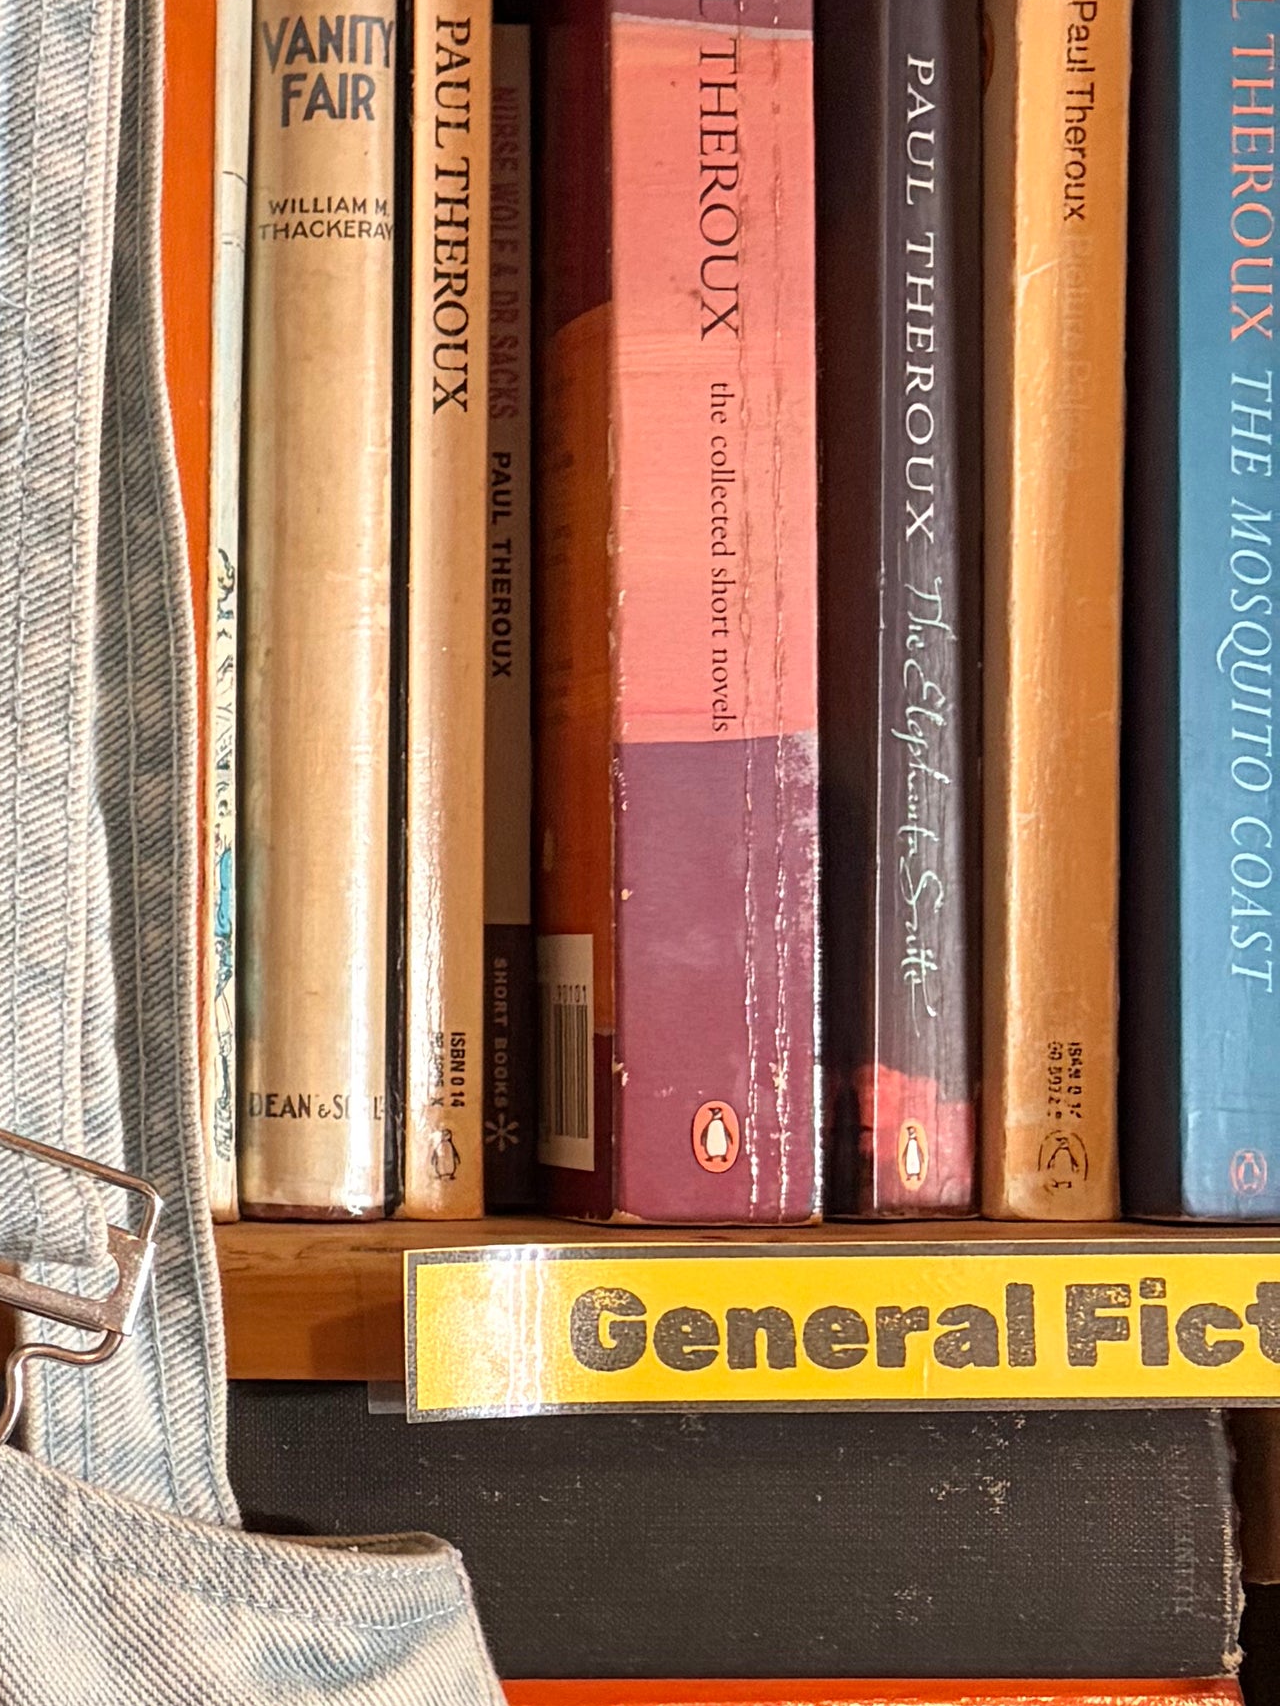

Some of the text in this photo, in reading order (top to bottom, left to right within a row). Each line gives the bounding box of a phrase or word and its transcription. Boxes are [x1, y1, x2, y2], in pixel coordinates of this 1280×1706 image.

[262, 14, 395, 75] VANITY
[280, 73, 376, 128] FAIR
[905, 54, 936, 206] PAUL
[1062, 0, 1098, 222] Paul Theroux
[258, 219, 395, 242] THACKERAY
[268, 197, 369, 218] WILLIAM
[431, 15, 472, 415] PAUL THEROUX
[698, 37, 741, 343] THEROUX
[1230, 35, 1275, 342] THEROUX
[708, 381, 730, 426] the
[904, 233, 936, 544] THEROUX
[1230, 370, 1274, 477] THE
[708, 433, 736, 558] collected
[490, 451, 512, 679] PAUL THEROUX
[709, 567, 737, 640] short
[711, 645, 738, 734] novels
[1215, 497, 1274, 794] MOSQUITO
[1230, 814, 1274, 994] COAST
[450, 1031, 466, 1108] ISBN 14
[491, 957, 509, 1116] SHORT BOOKS
[570, 1281, 1035, 1372] General
